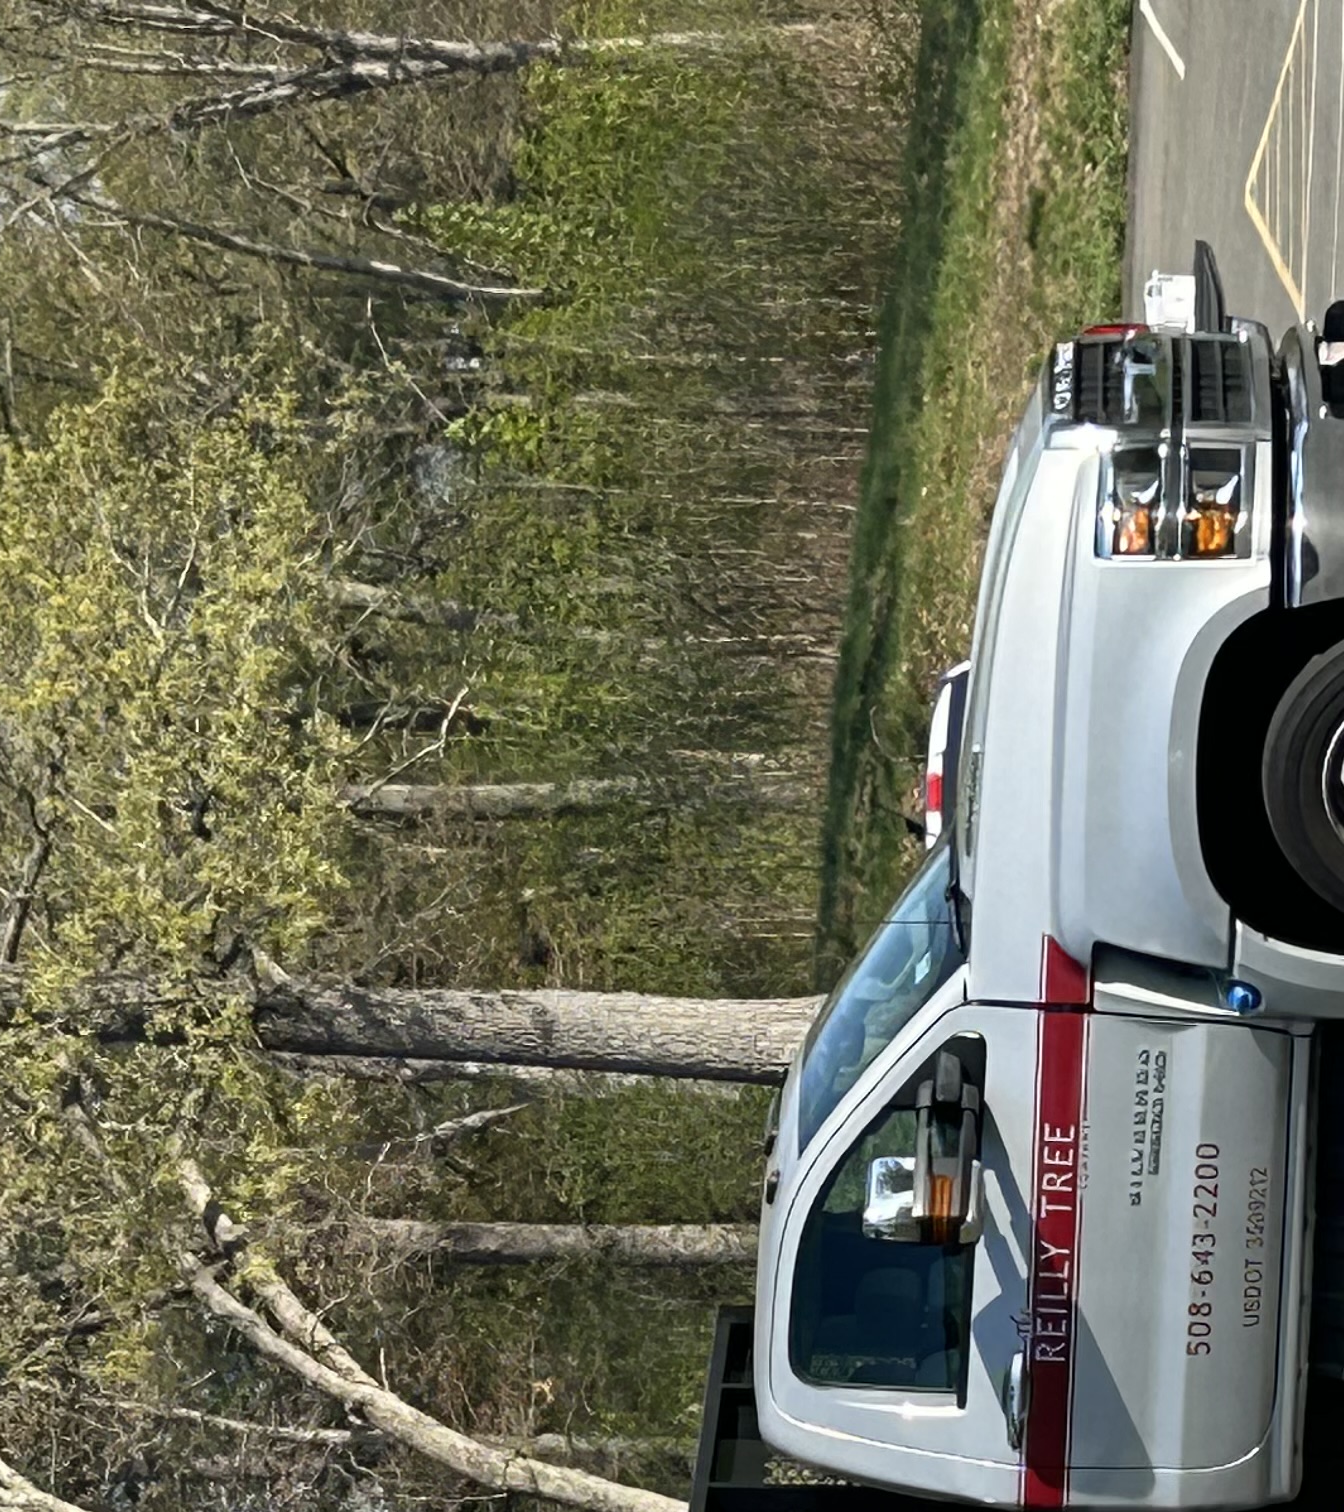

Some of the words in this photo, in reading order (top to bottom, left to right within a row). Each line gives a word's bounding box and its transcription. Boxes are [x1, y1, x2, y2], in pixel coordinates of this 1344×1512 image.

[1039, 1122, 1075, 1218] TREE
[1034, 1240, 1071, 1362] REILLY
[1186, 1142, 1220, 1357] 508-643-2200
[1242, 1258, 1263, 1328] USDOT
